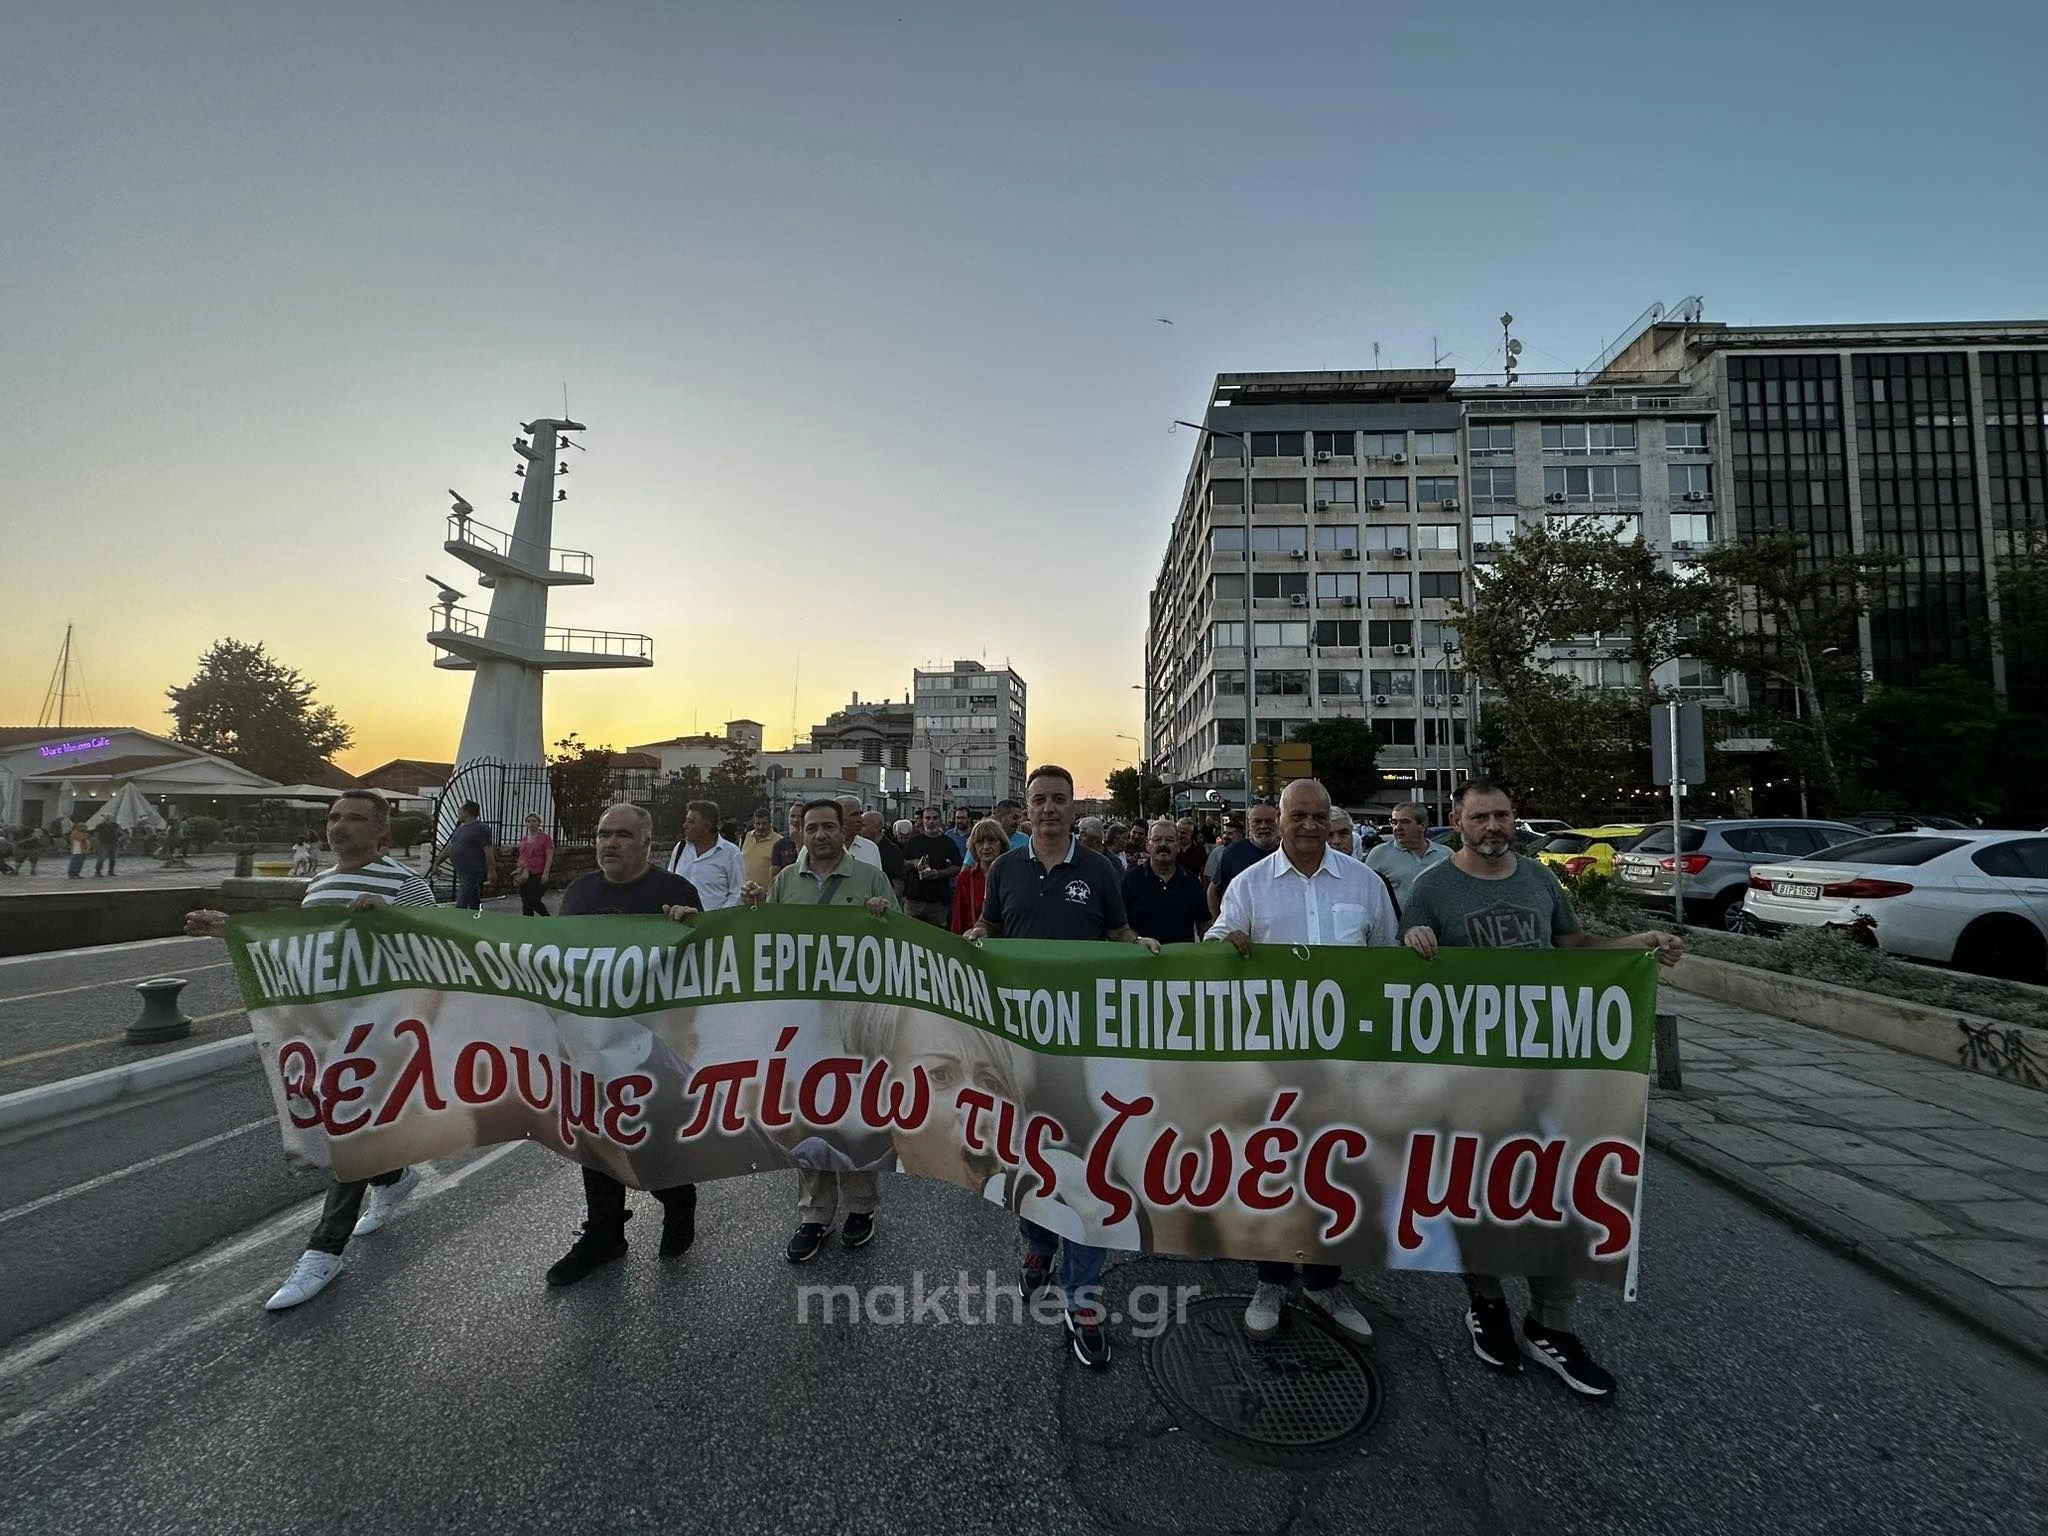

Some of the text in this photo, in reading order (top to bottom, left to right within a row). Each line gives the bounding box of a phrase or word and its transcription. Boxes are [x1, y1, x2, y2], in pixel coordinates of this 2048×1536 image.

[1472, 912, 1535, 947] NEW
[474, 934, 742, 1009] ΟΜΟΣΠΟΝΔΙΑ
[753, 933, 996, 1026] ΕΡΓΑΖΟΜΕΝΩΝ
[997, 986, 1081, 1046] ΣΤΟΝ
[1096, 979, 1346, 1052] ΕΠΙΣΙΤΙΣΜΟ
[1358, 1018, 1373, 1033] -
[1384, 983, 1632, 1061] ΤΟΥΡΙΣΜΟ
[681, 1026, 931, 1138] πίσω
[955, 1087, 1064, 1198] τις
[1085, 1090, 1368, 1240] ζωές
[1397, 1133, 1641, 1257] μας
